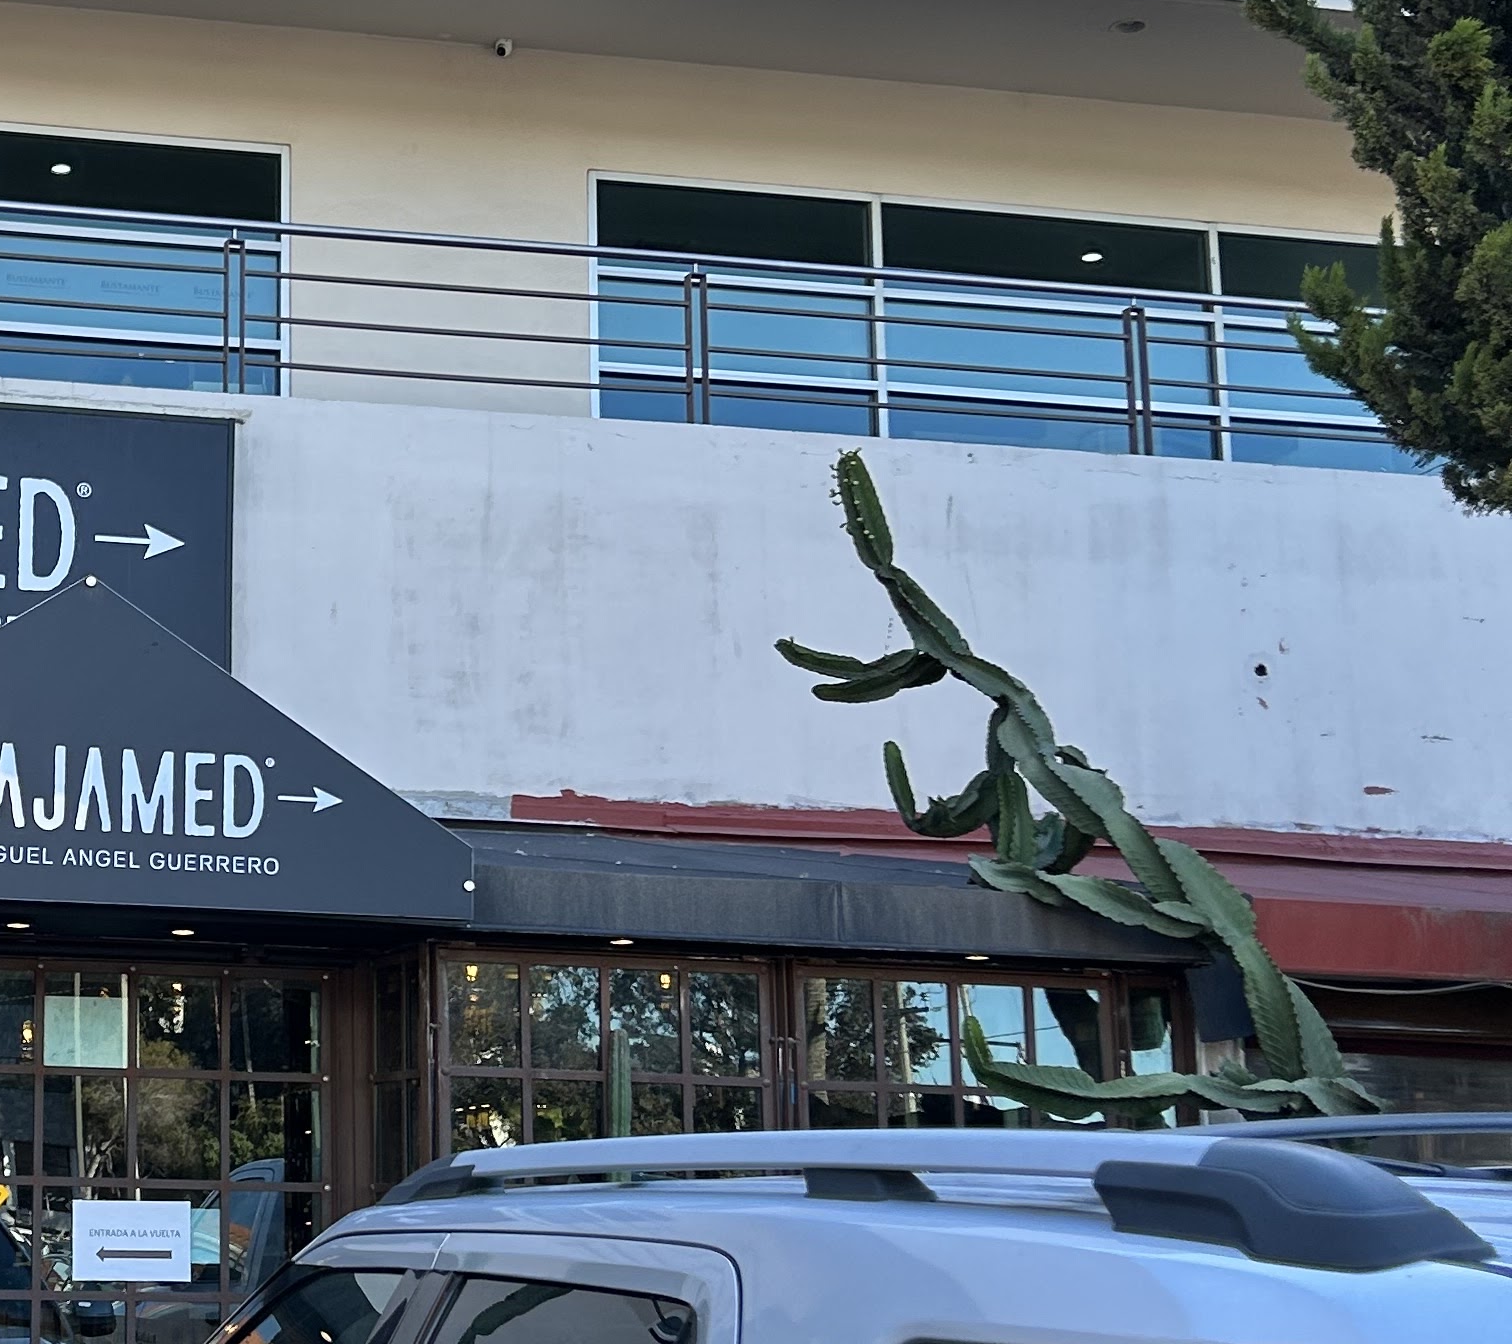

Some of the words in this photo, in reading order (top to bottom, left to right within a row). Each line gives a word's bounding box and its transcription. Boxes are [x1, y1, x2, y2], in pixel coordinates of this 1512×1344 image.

[62, 848, 141, 869] ANGEL
[149, 852, 280, 875] GUERRERO
[89, 1228, 129, 1238] ENTRADA
[130, 1229, 137, 1238] A
[138, 1229, 148, 1238] LA
[150, 1229, 181, 1239] VUELTA
